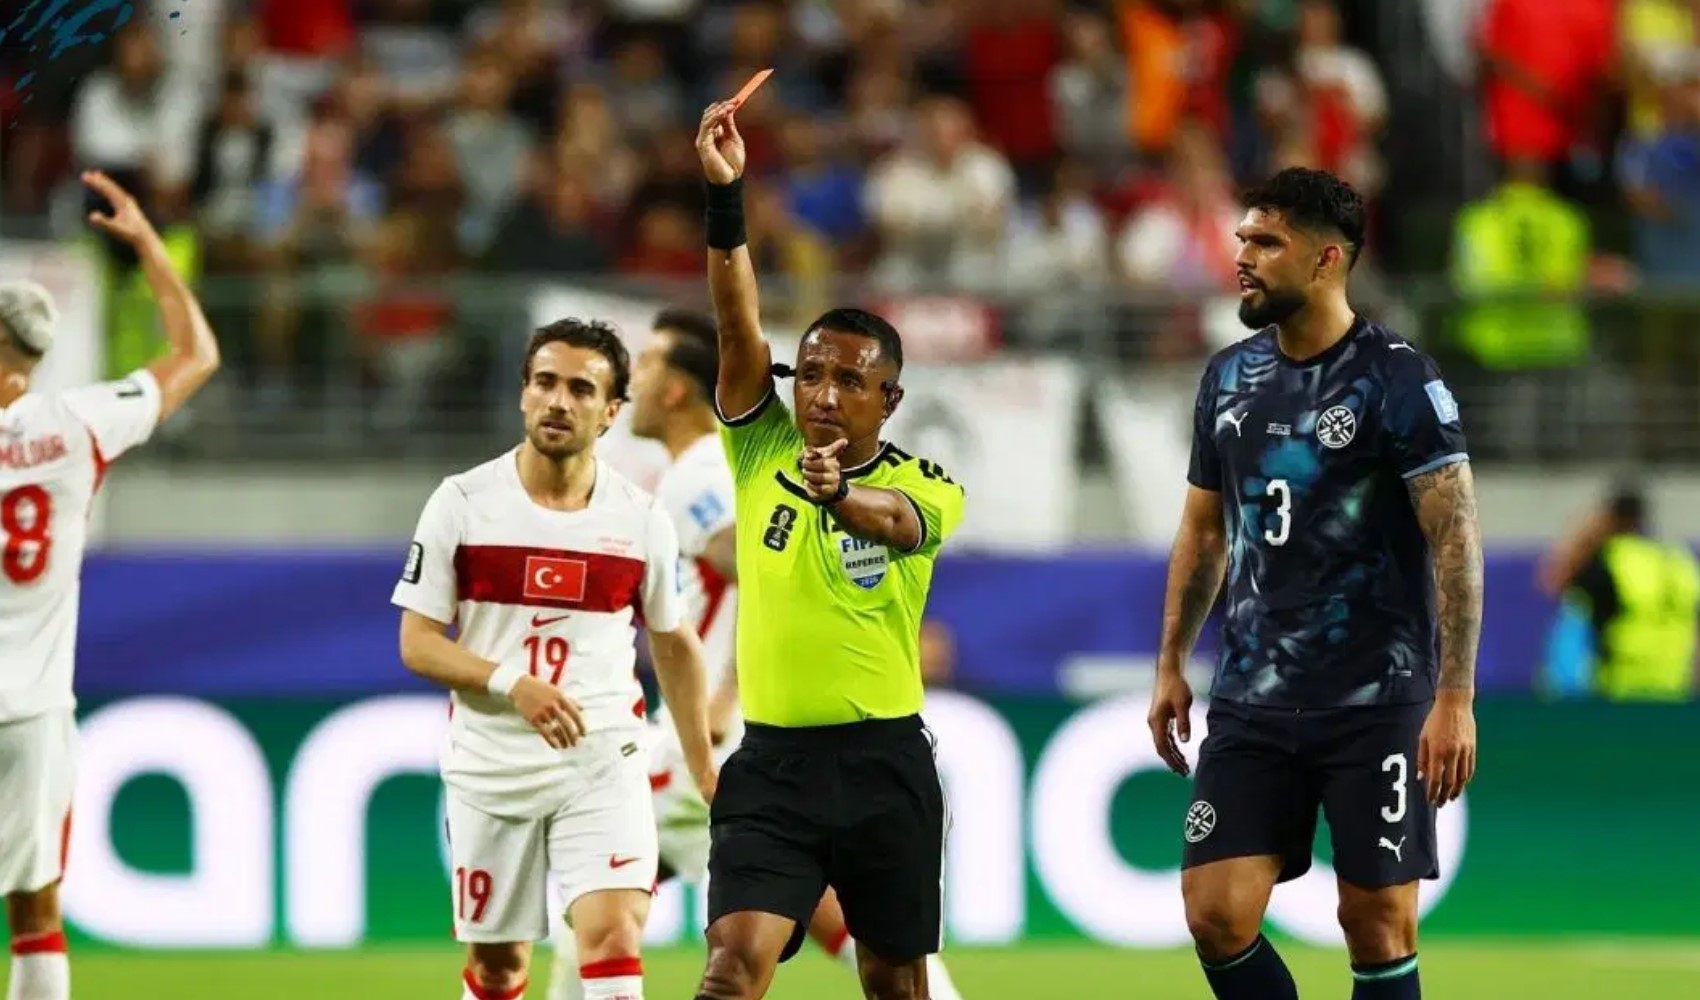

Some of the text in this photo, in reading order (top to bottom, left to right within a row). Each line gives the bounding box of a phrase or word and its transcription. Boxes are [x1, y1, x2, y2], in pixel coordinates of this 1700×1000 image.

[1265, 479, 1291, 546] 3
[841, 538, 875, 552] FIF
[523, 635, 569, 687] 19
[1382, 753, 1407, 823] 3
[456, 867, 492, 923] 19
